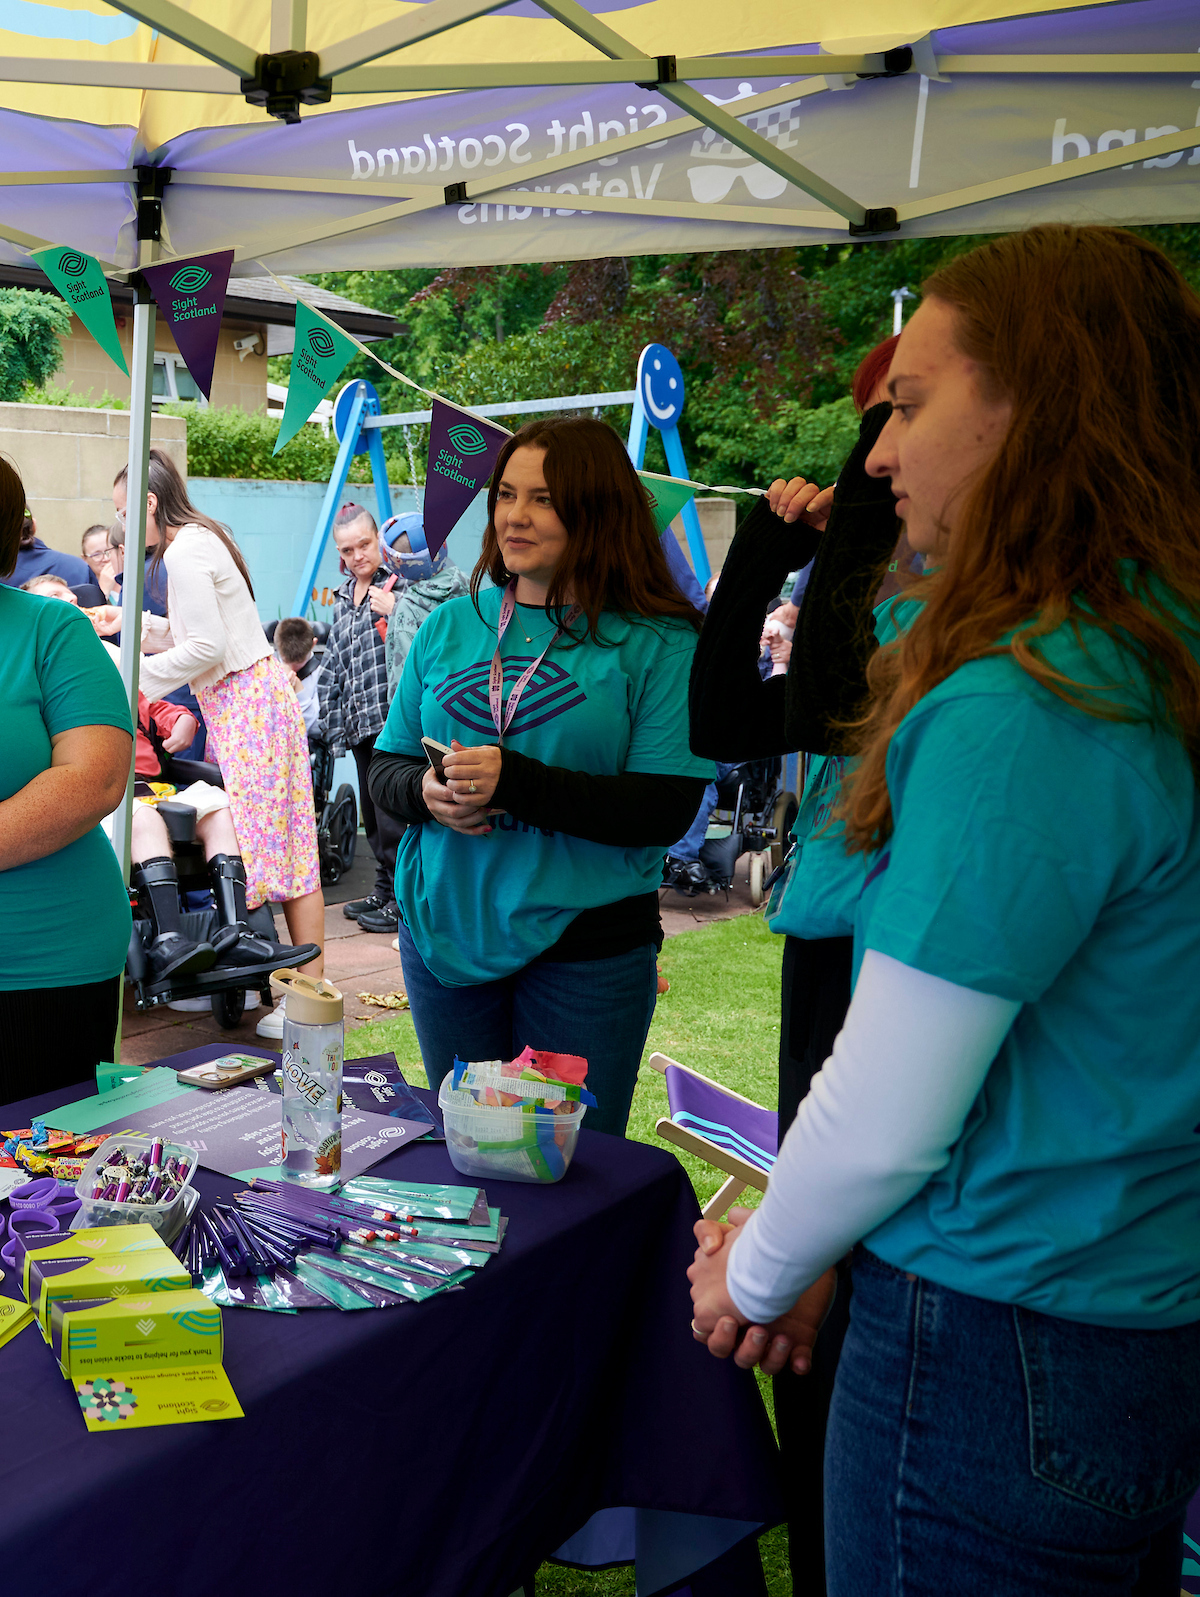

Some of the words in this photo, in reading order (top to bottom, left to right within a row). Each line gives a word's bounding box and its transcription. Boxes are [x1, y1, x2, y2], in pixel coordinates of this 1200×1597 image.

[66, 279, 87, 293] Sight
[71, 286, 105, 304] Scotland
[171, 296, 198, 312] Sight
[173, 303, 217, 322] Scotland
[299, 347, 318, 369] Sight
[295, 359, 327, 390] Scotland
[437, 448, 464, 470] Sight
[432, 461, 477, 490] Scotland
[283, 1051, 327, 1106] LOVE
[114, 1355, 134, 1363] tackle
[143, 1351, 168, 1360] helping
[180, 1348, 192, 1357] you
